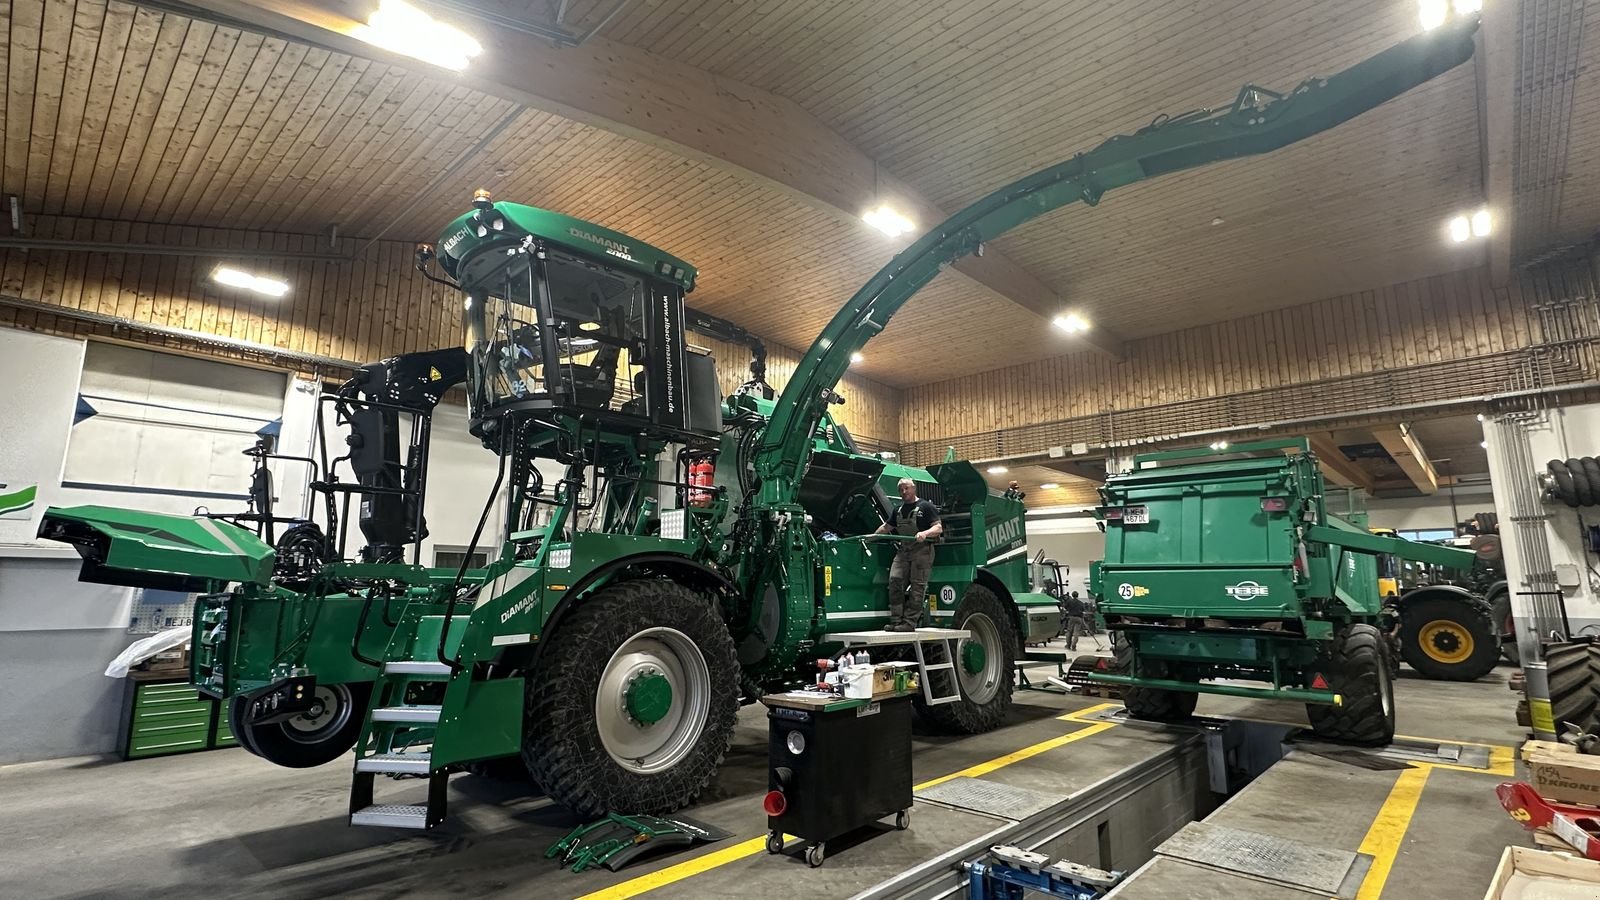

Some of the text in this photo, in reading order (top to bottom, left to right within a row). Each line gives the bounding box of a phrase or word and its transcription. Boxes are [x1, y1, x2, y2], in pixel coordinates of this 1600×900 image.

[443, 226, 470, 252] ALBACH
[663, 295, 674, 413] www.albach-maschinenbau.de
[985, 516, 1020, 550] MANT
[943, 589, 953, 600] 80
[1121, 586, 1131, 596] 25
[1225, 586, 1269, 596] TEBBE
[1549, 780, 1600, 792] KRONE
